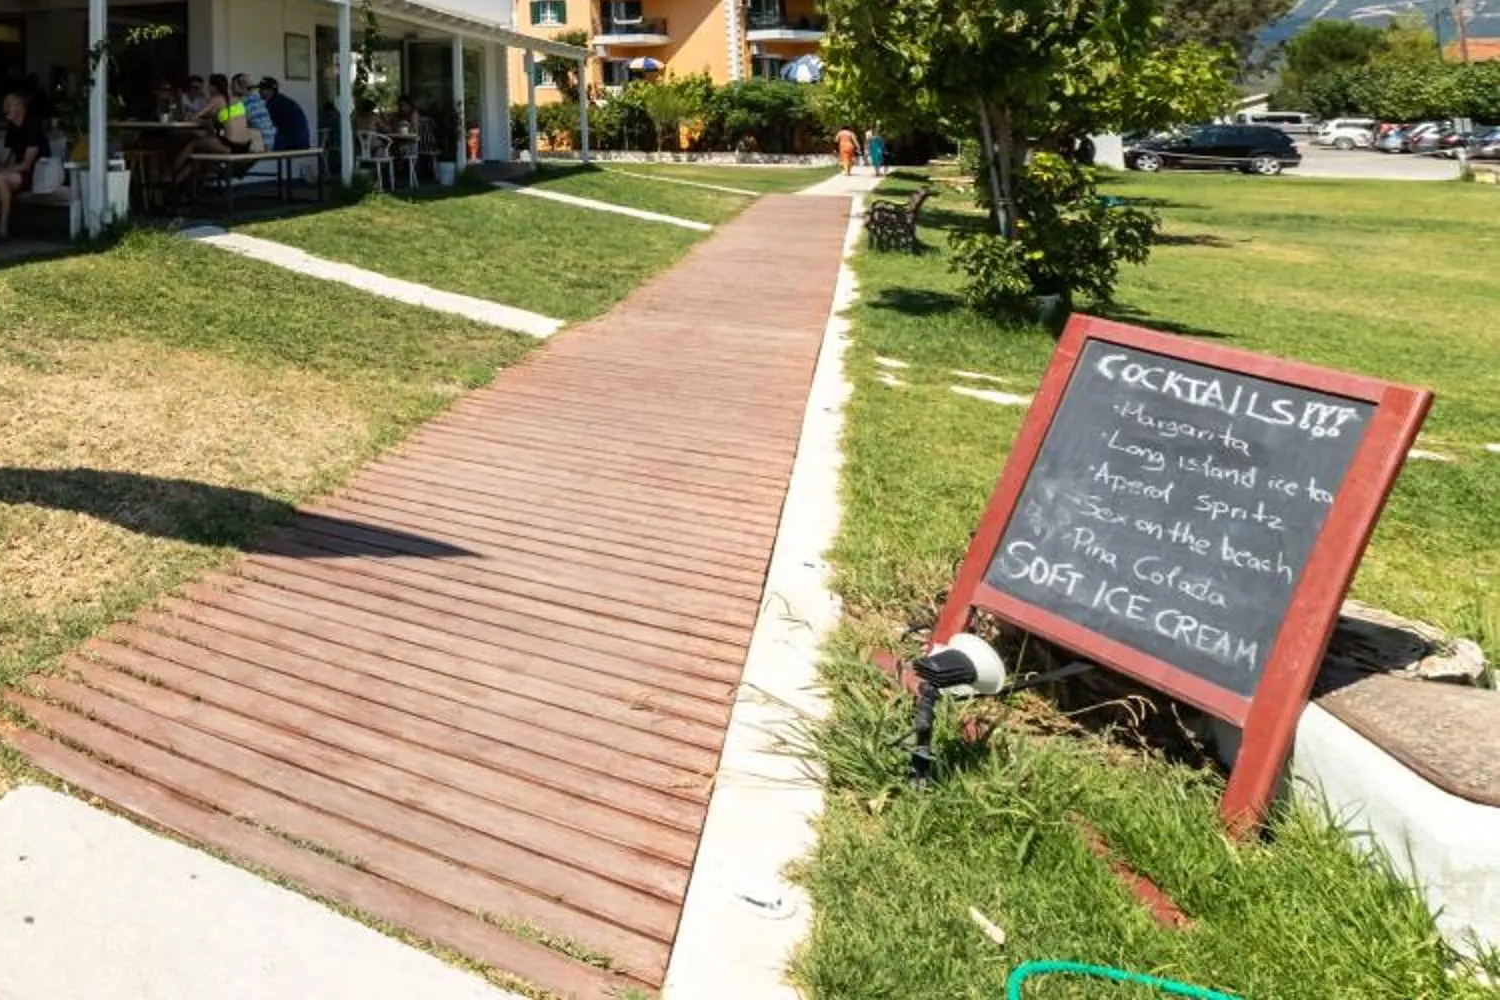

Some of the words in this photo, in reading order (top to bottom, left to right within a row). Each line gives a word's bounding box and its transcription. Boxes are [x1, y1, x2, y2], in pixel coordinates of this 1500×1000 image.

[1108, 429, 1165, 470] Long
[1094, 462, 1174, 503] Aperol
[1167, 521, 1211, 556] the
[1222, 533, 1293, 585] beach
[1007, 540, 1085, 596] SOFT
[1092, 580, 1151, 622] ICE
[1155, 609, 1258, 673] CREAM
[1133, 556, 1227, 608] Colada
